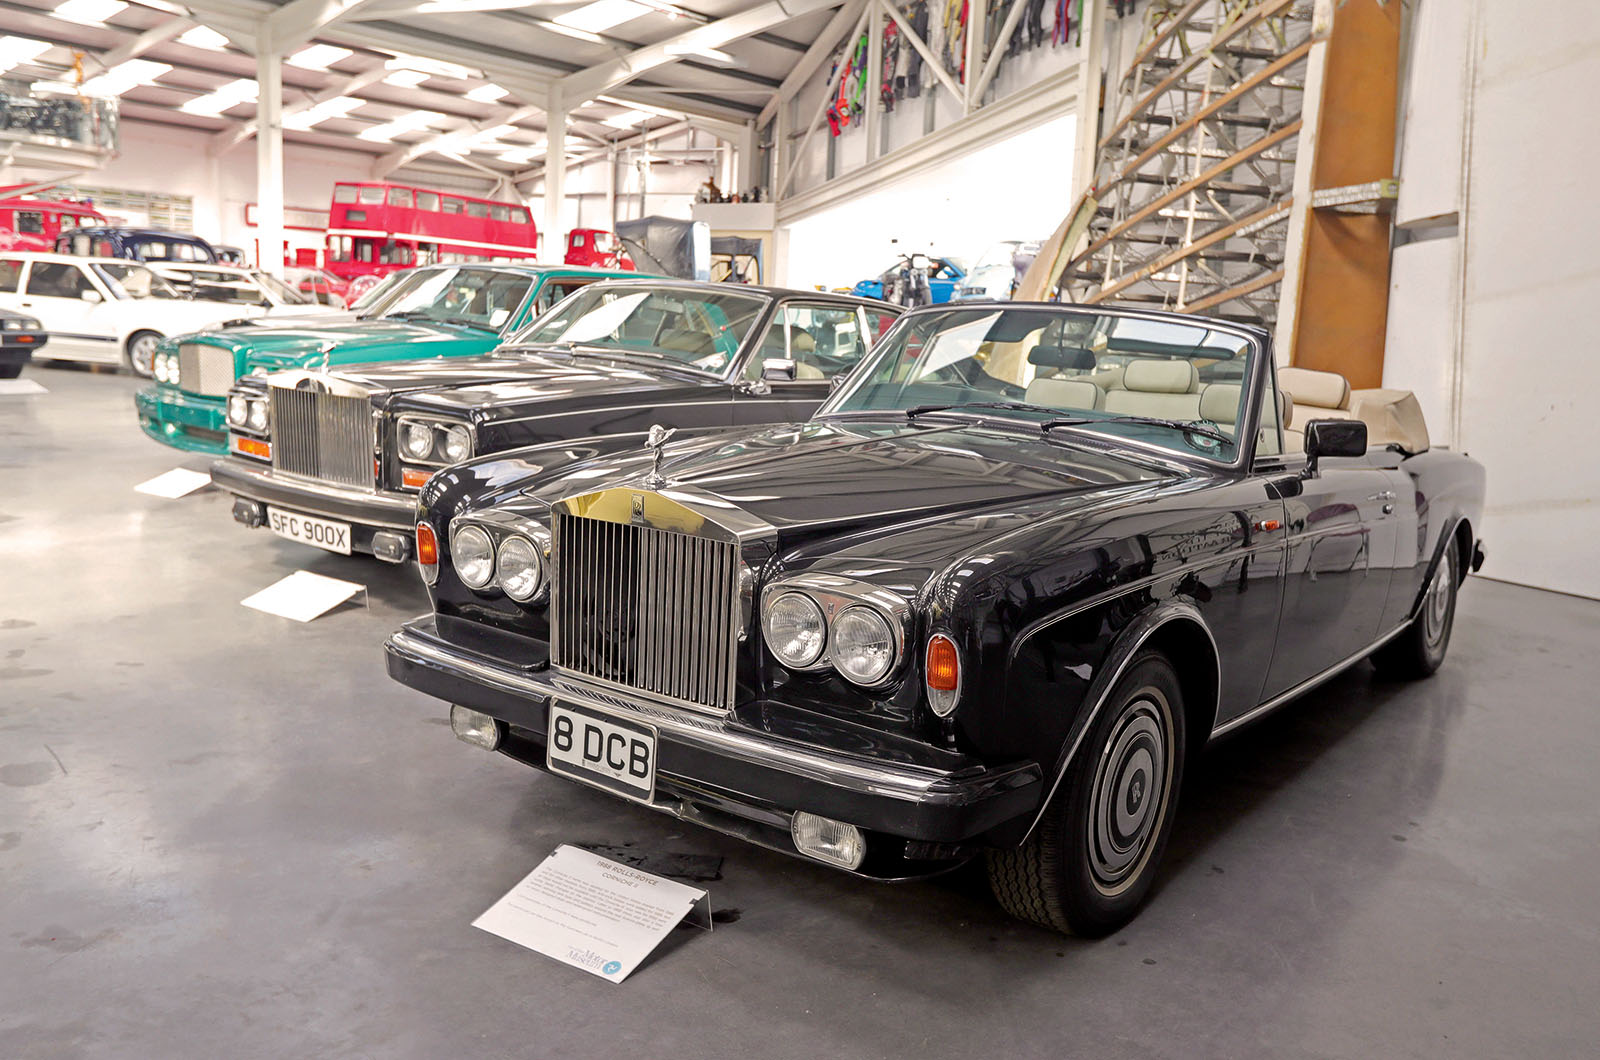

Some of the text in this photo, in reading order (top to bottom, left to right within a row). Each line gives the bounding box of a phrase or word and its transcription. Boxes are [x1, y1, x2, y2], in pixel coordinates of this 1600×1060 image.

[271, 512, 346, 548] SFC 900X
[554, 715, 650, 779] 8 DCB
